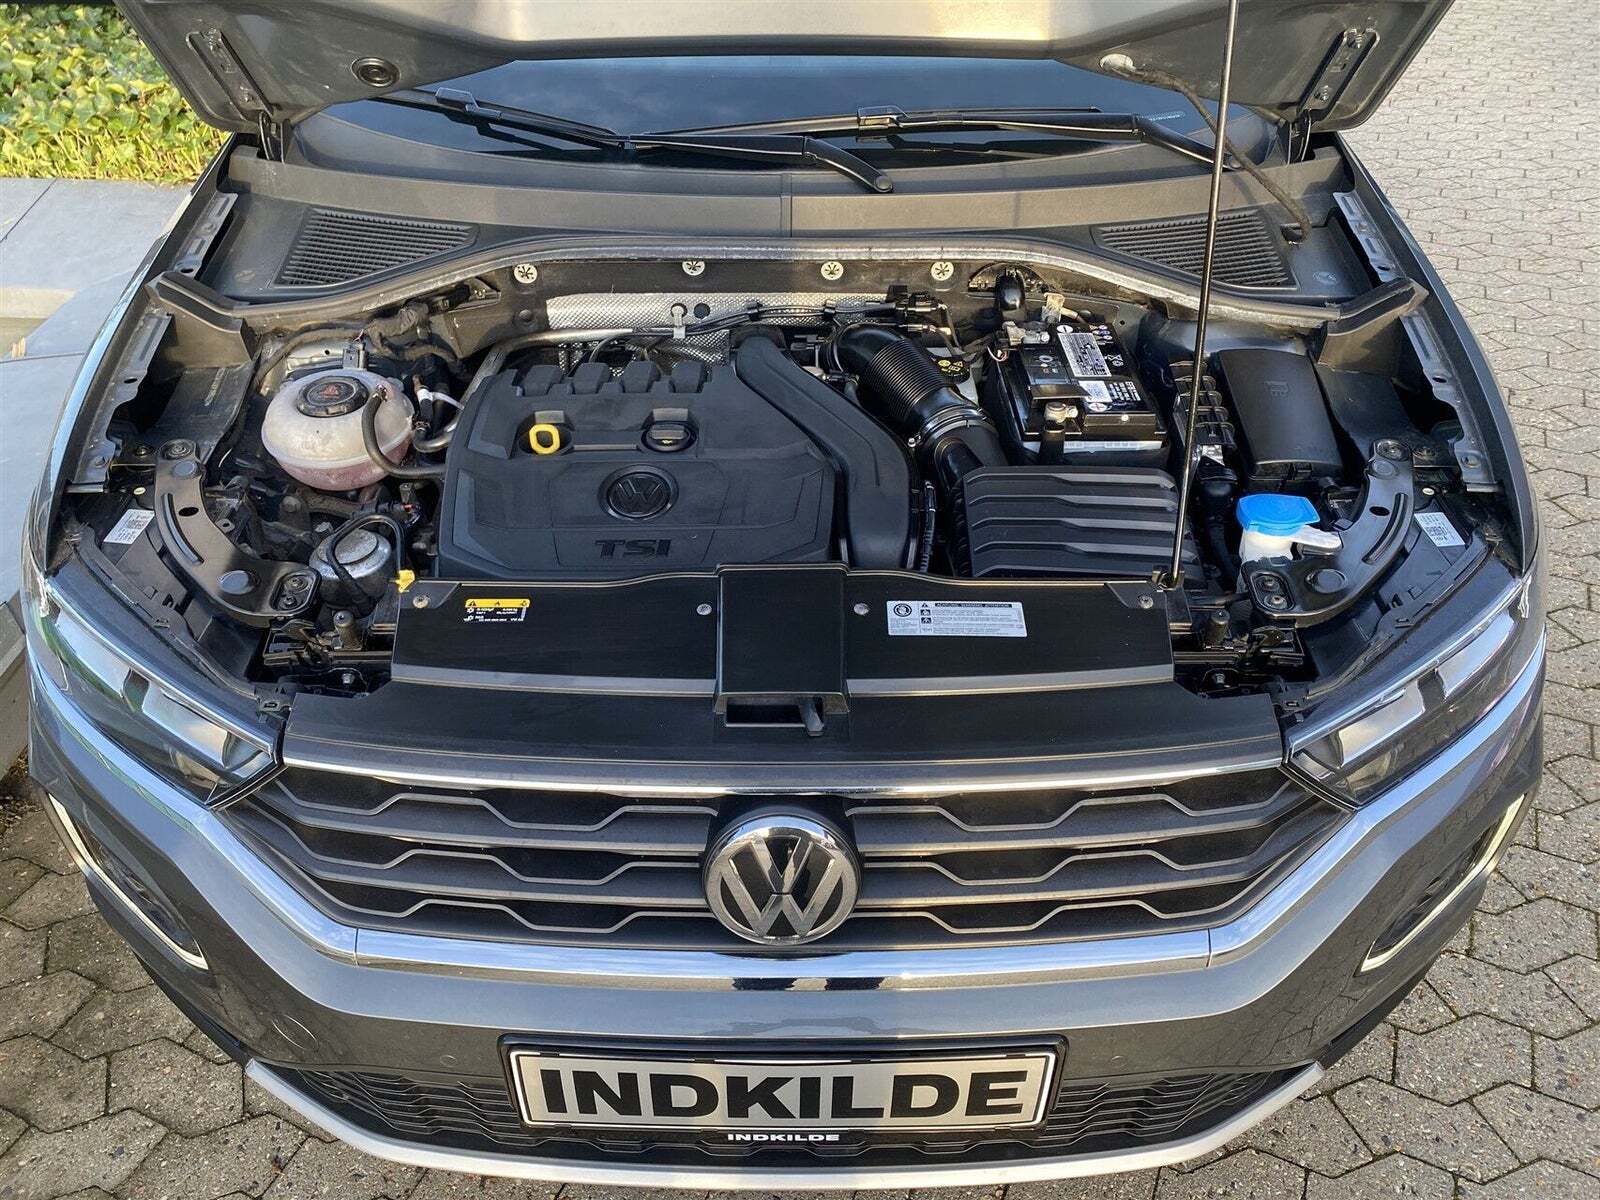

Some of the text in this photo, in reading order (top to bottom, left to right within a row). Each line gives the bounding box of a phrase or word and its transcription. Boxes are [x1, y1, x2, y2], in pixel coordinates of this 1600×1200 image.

[595, 540, 672, 558] TSI
[710, 828, 853, 941] VW
[540, 1069, 1028, 1119] INDKILDE
